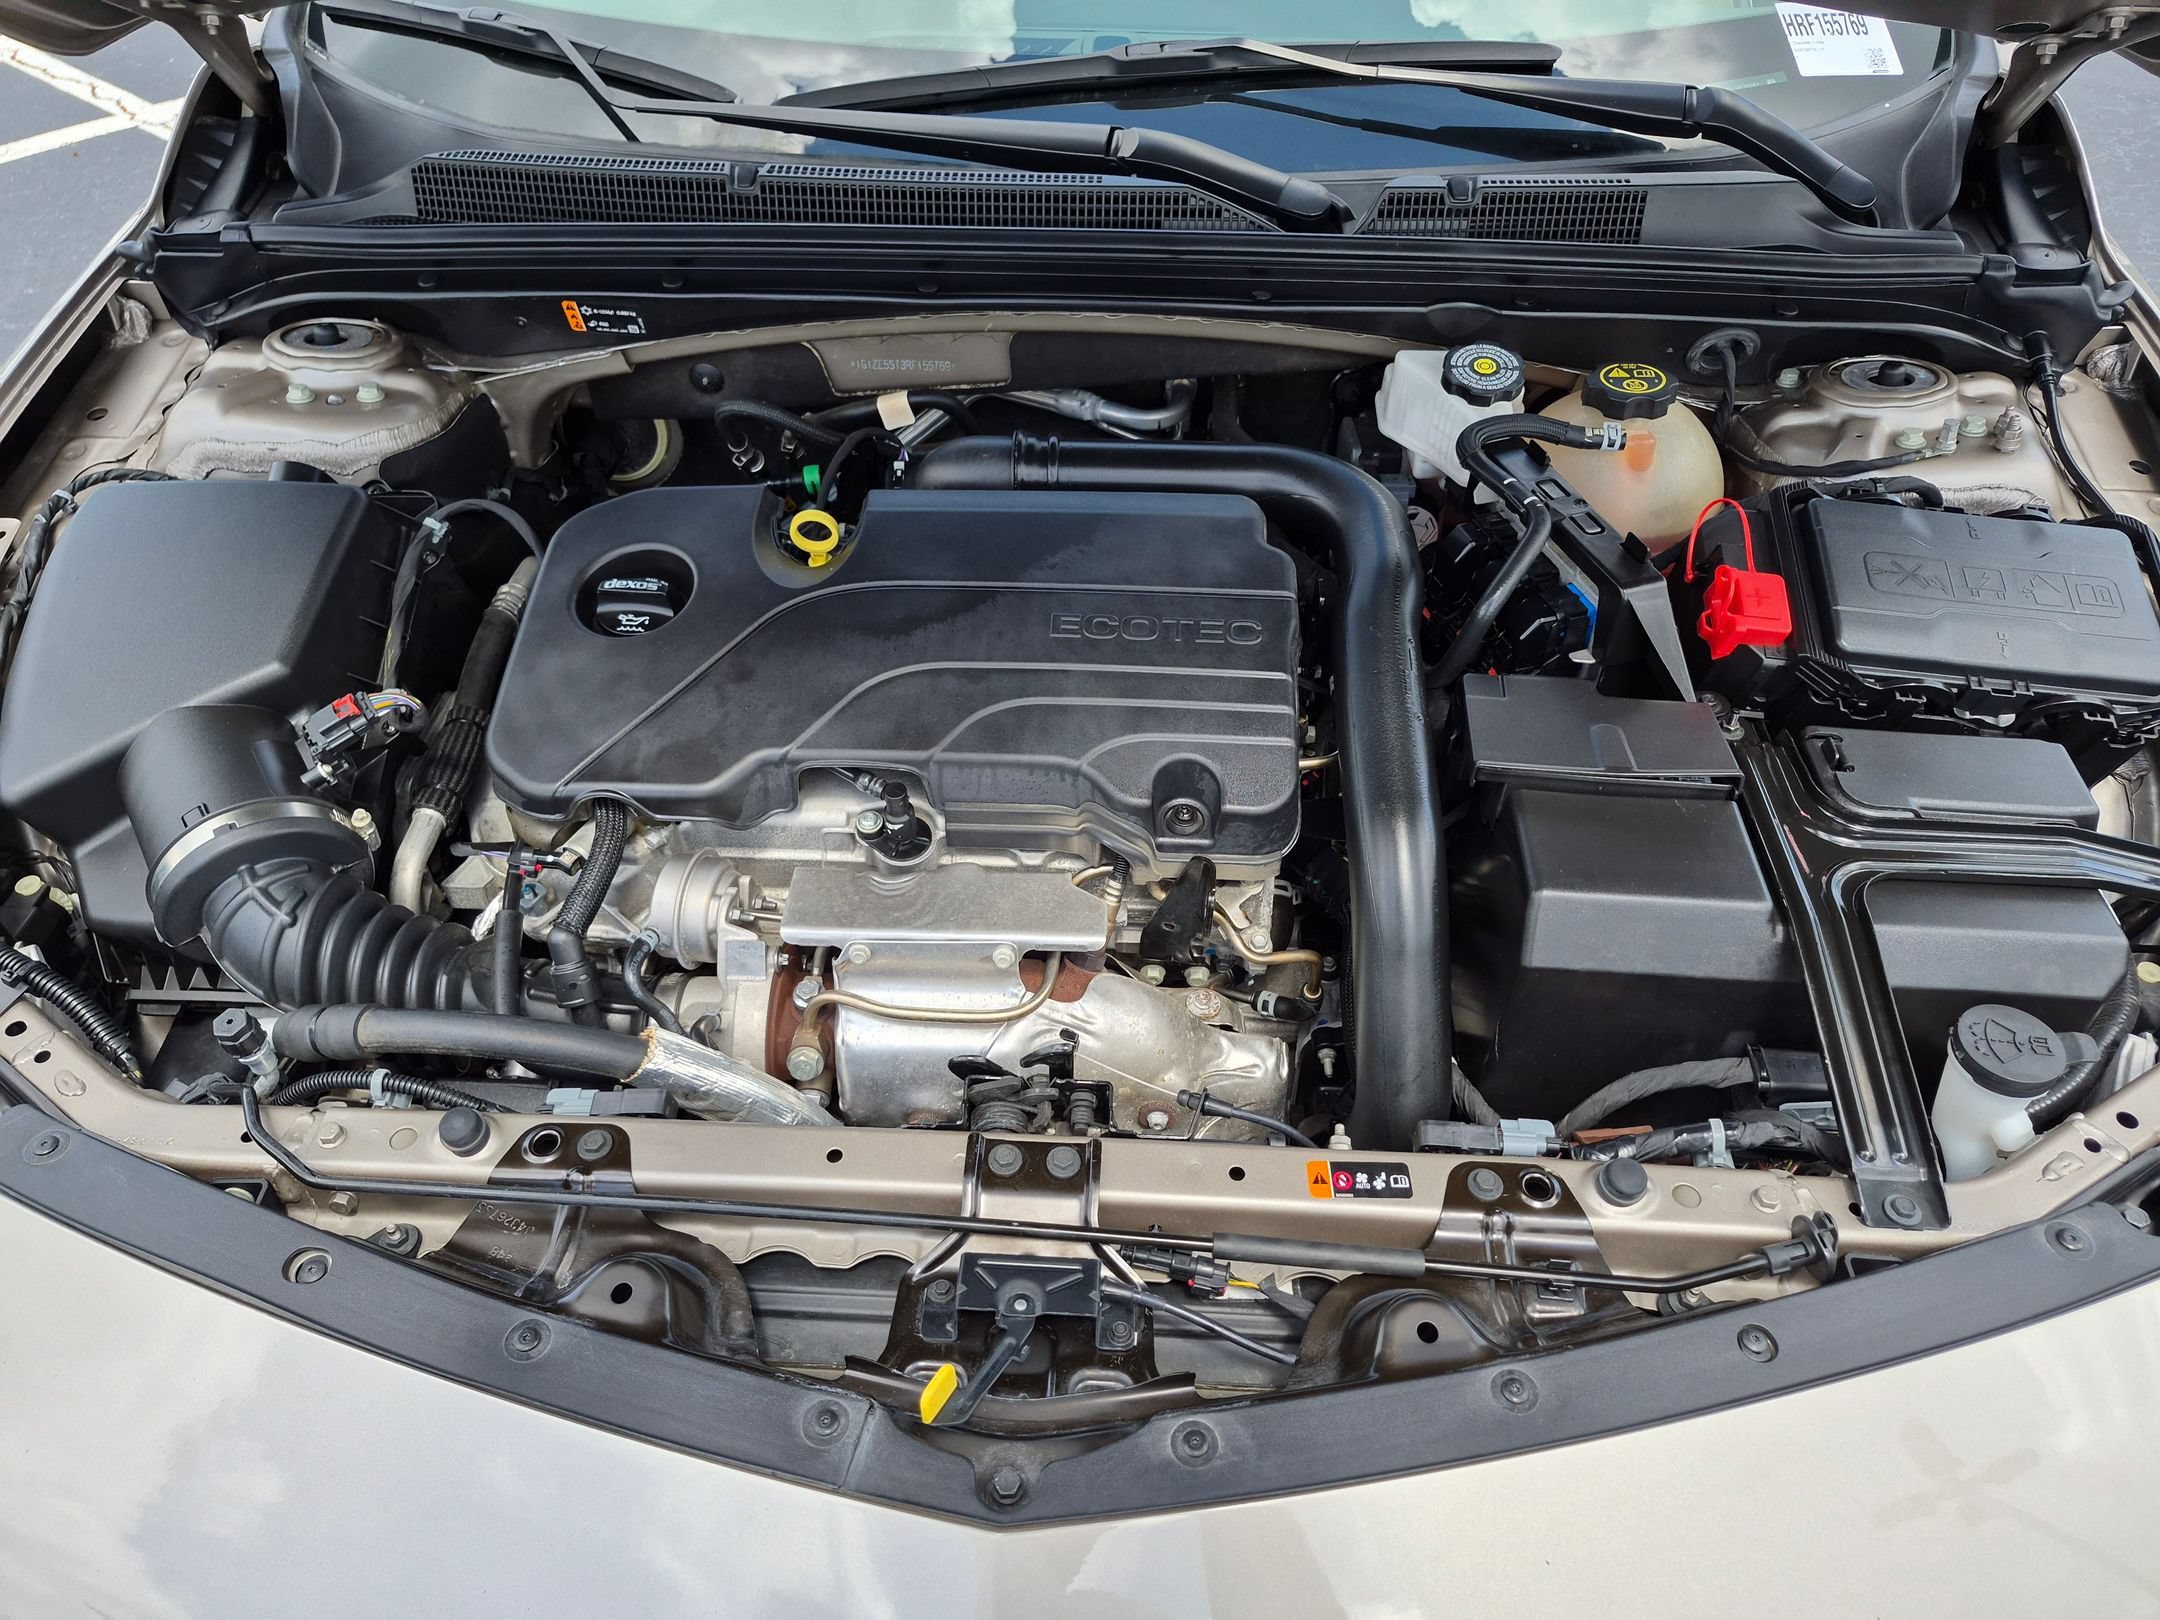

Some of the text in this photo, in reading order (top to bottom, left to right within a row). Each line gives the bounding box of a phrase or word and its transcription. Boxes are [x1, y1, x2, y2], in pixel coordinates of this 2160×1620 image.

[1782, 12, 1868, 36] HRF155769
[604, 578, 659, 591] dexos
[1050, 613, 1262, 645] ECOTEC
